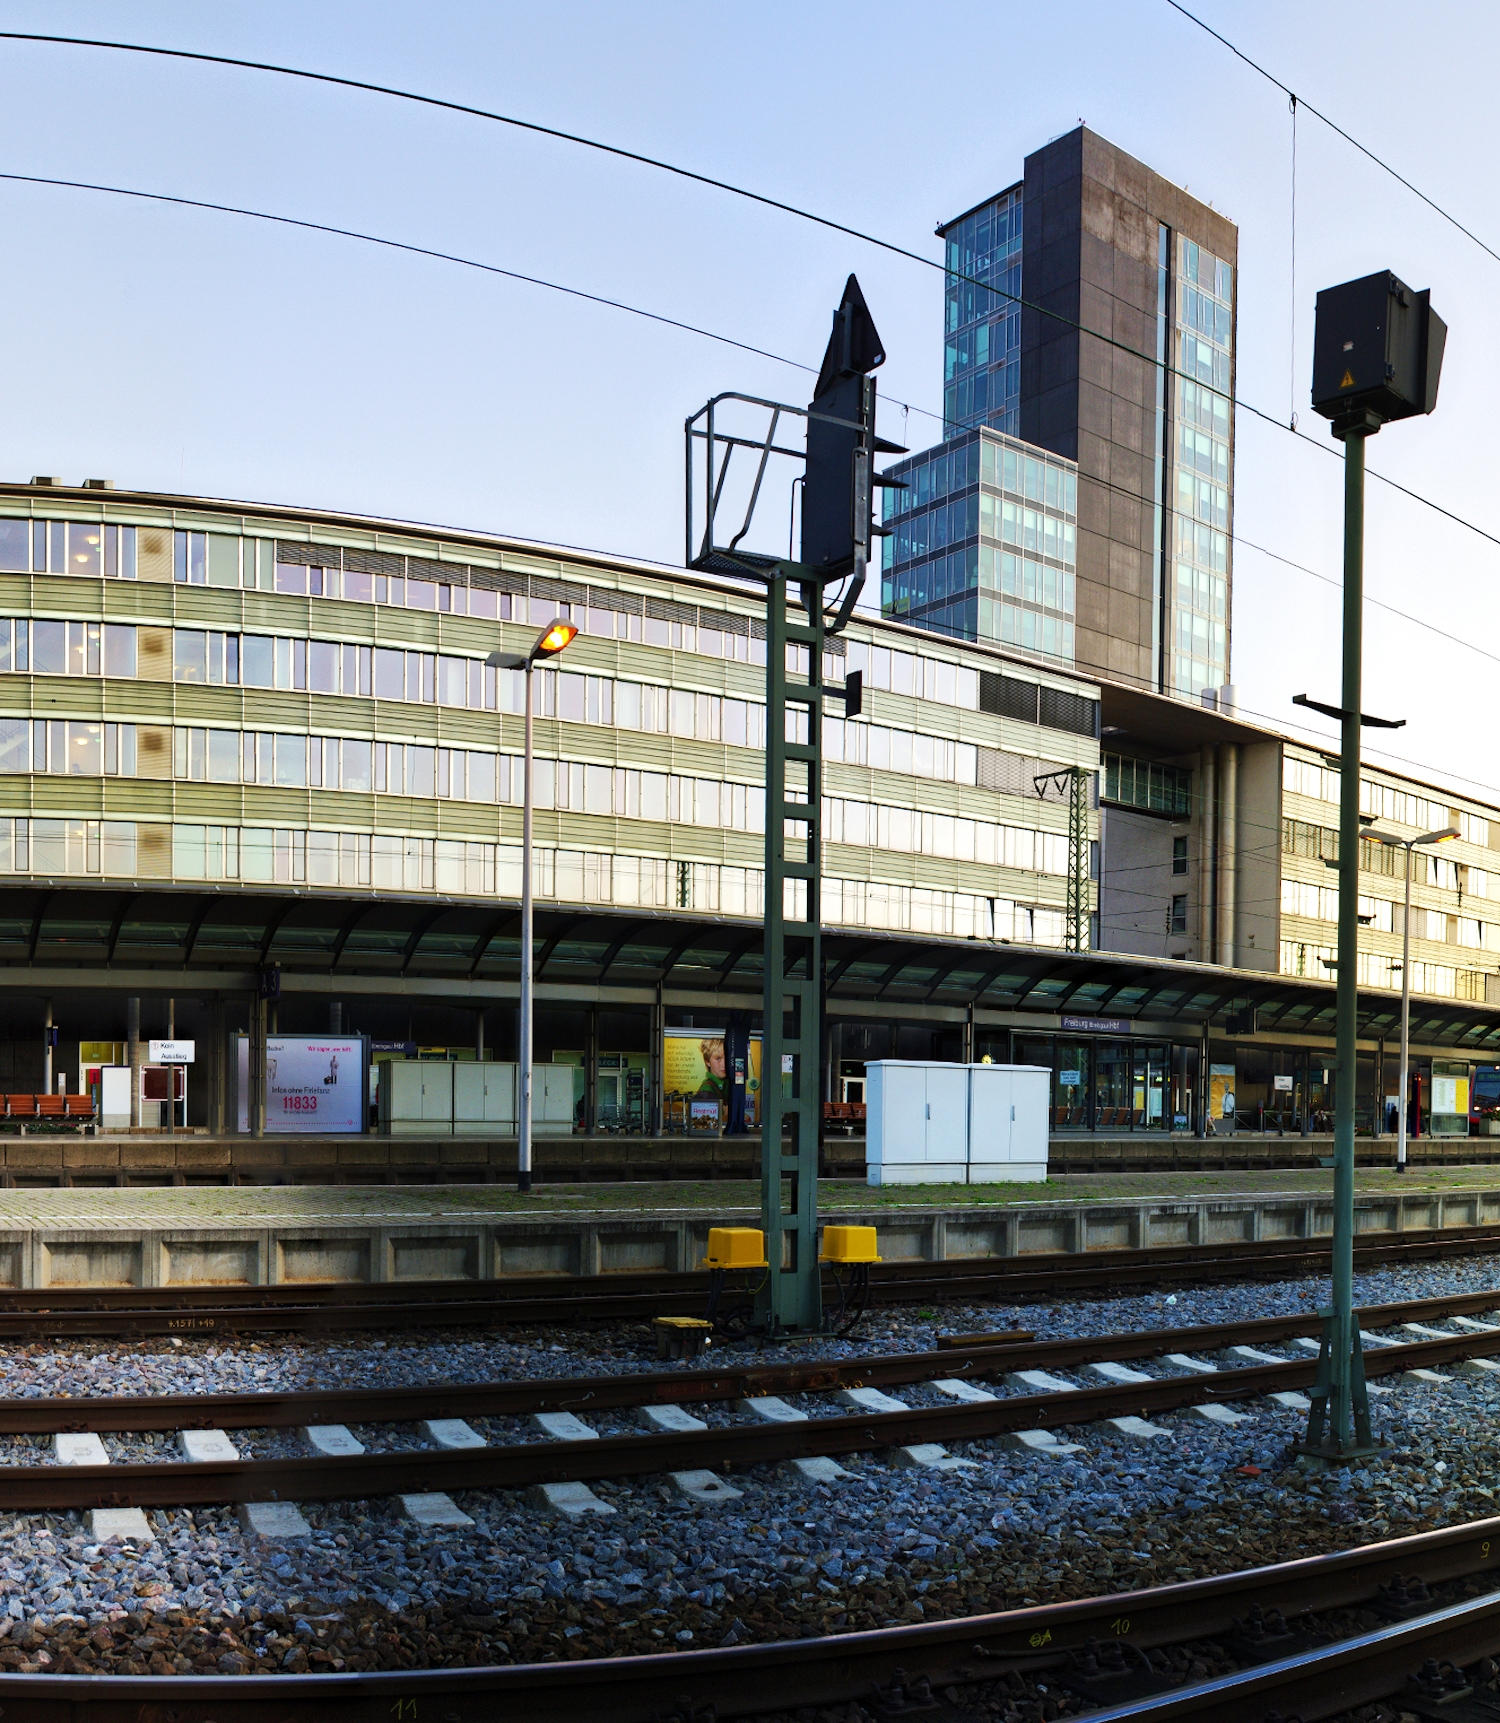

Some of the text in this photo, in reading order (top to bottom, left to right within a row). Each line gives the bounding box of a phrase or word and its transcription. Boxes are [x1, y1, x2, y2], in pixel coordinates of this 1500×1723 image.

[282, 1095, 317, 1110] 11833
[1480, 1541, 1490, 1559] 9
[390, 1698, 417, 1720] 11
